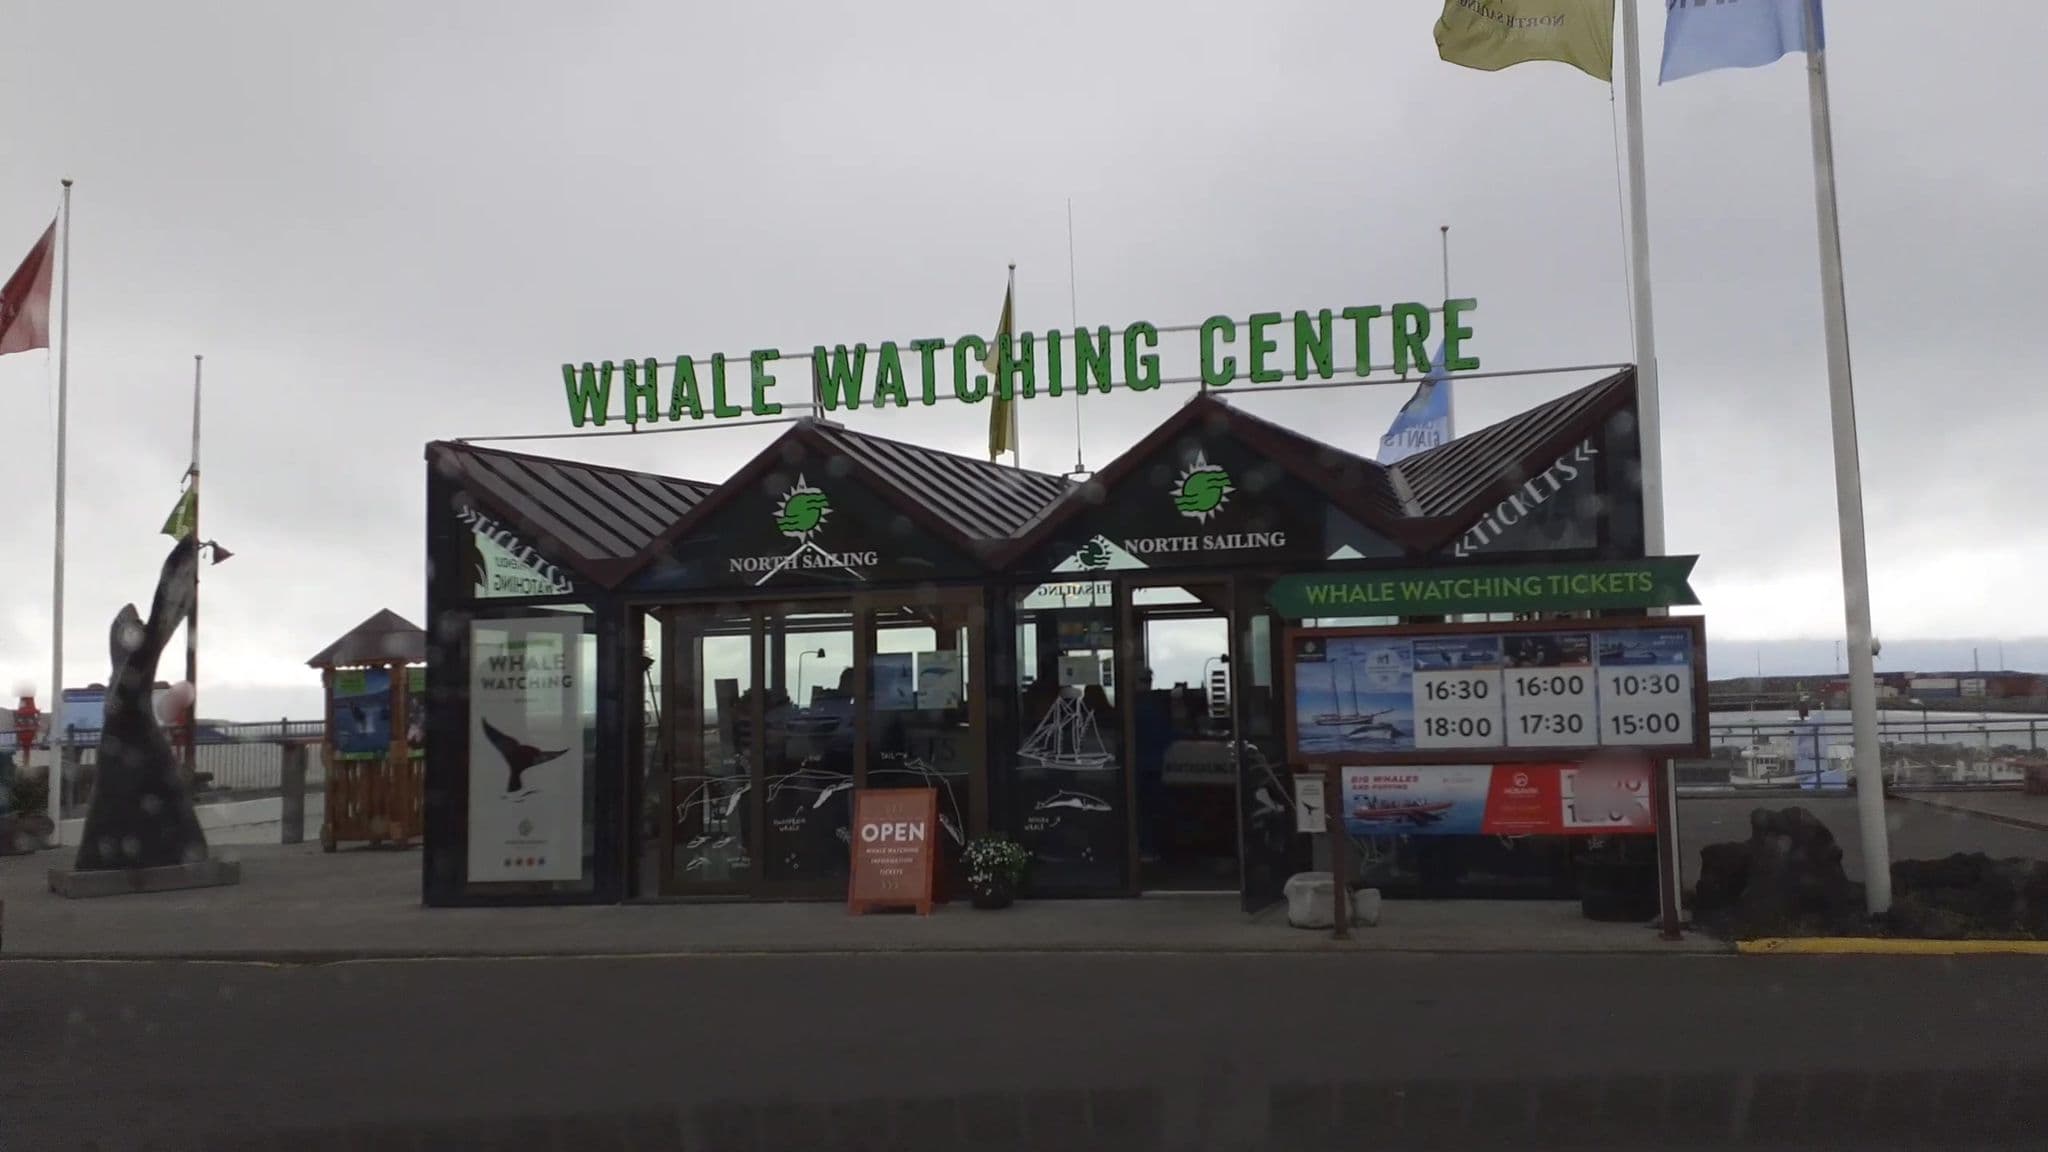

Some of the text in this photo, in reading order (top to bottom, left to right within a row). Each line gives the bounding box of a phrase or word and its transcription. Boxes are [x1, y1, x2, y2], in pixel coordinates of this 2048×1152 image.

[562, 298, 1480, 427] WHALE WATCHING CENTRE
[1124, 531, 1286, 553] NORTH SAILING
[729, 551, 879, 573] NORTH SAILING
[1305, 571, 1653, 605] WHALE WATCHING TICKETS
[488, 653, 566, 672] WHALE
[480, 674, 573, 691] WATCHING
[1425, 679, 1489, 700] 16:30
[1516, 675, 1584, 696] 16:00
[1612, 673, 1680, 696] 10:30
[1425, 717, 1492, 737] 18:00
[1520, 713, 1583, 734] 17:30
[1612, 712, 1680, 734] 15:00
[1373, 775, 1419, 784] WHALES
[861, 822, 926, 843] OPEN
